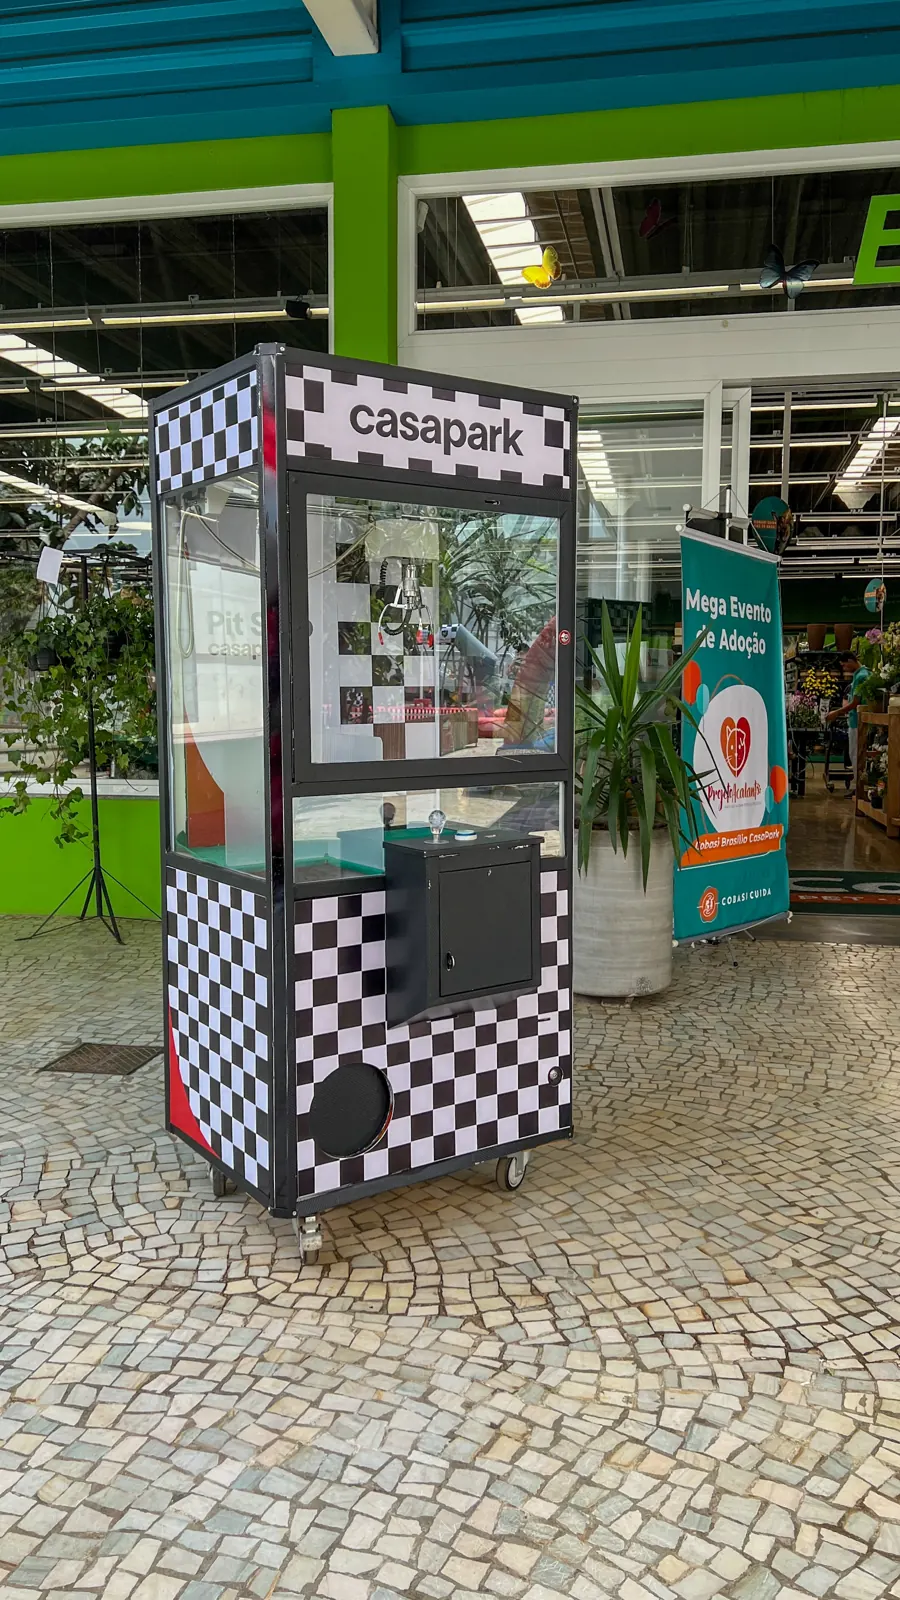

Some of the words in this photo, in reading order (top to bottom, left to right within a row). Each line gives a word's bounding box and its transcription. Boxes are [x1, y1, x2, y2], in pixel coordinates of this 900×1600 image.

[350, 404, 524, 456] casapark
[686, 588, 727, 620] Mega
[730, 596, 772, 623] Evento
[207, 611, 244, 636] Pit
[719, 628, 766, 659] Adoção
[721, 892, 748, 906] COBASI
[749, 888, 772, 900] CUIDA
